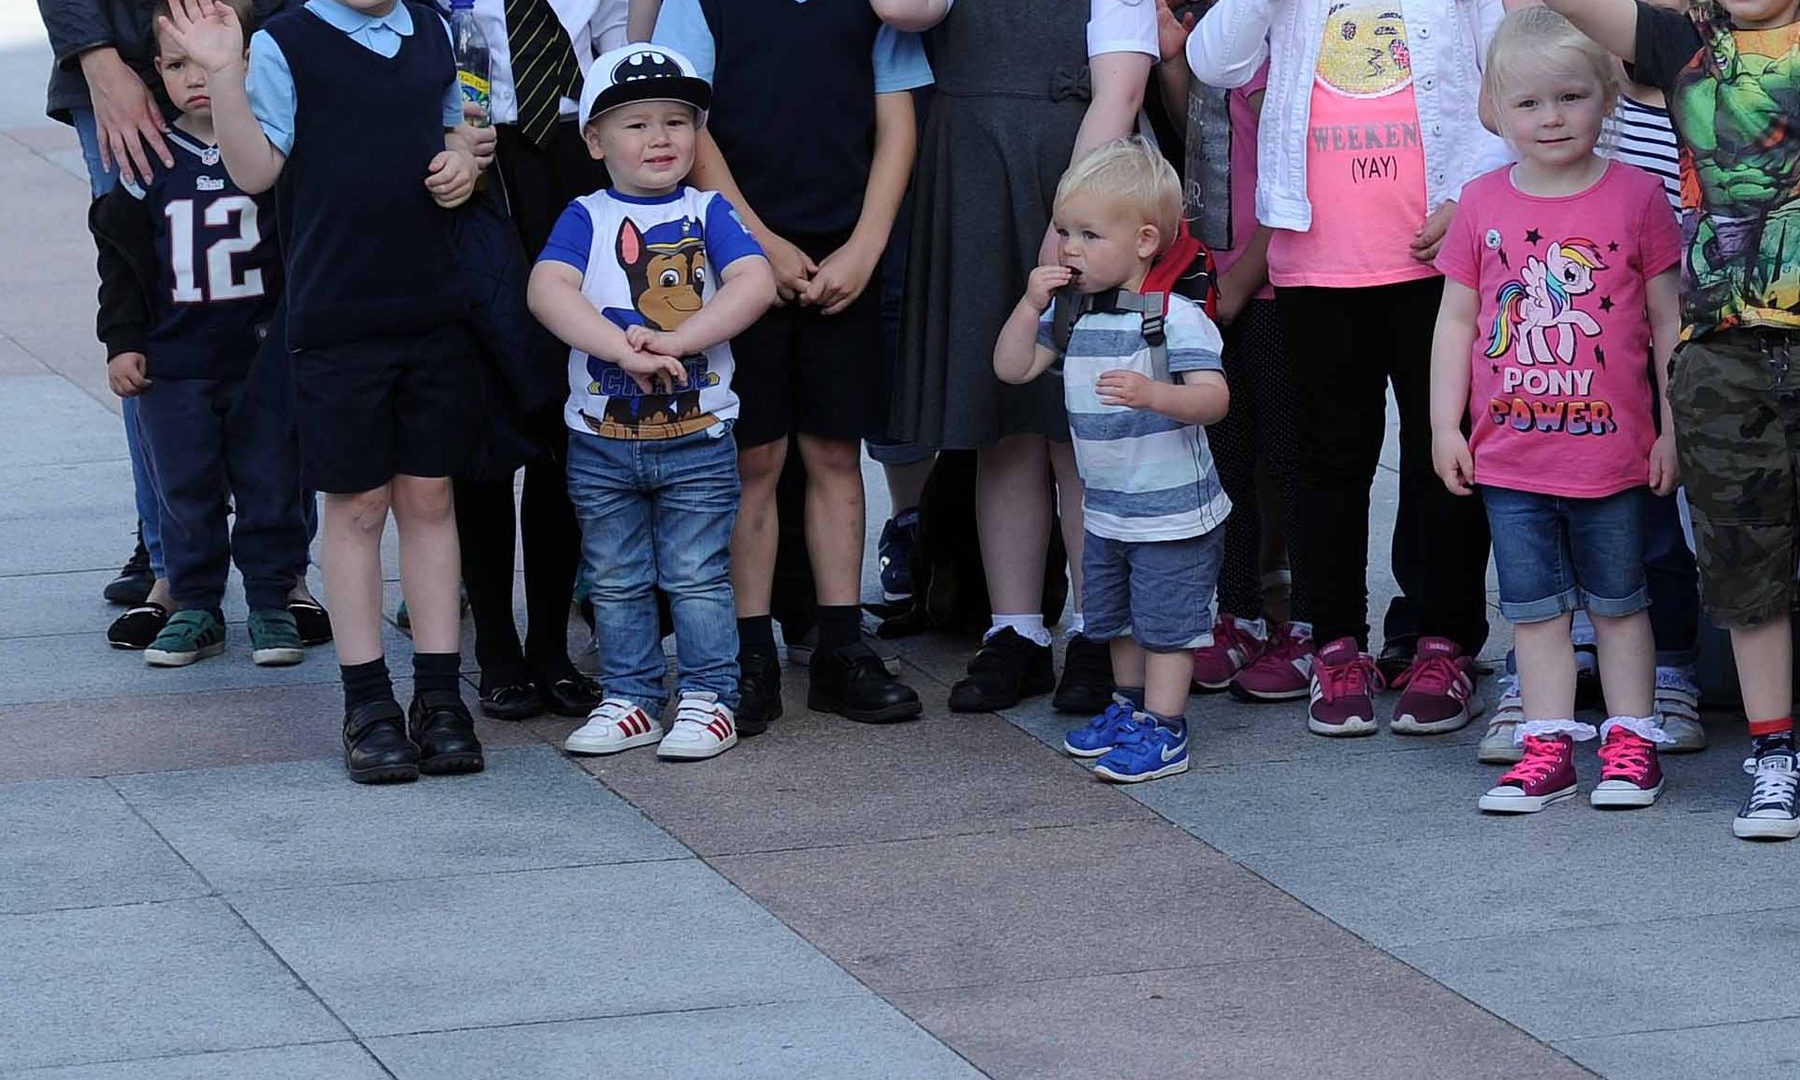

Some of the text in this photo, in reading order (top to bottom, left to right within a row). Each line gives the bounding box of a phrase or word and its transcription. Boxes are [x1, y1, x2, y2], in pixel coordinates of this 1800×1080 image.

[1312, 122, 1418, 152] WEEKEN
[1351, 155, 1398, 184] (YAY)
[164, 195, 265, 302] 12
[1502, 366, 1594, 396] PONY
[1488, 396, 1617, 435] POWER
